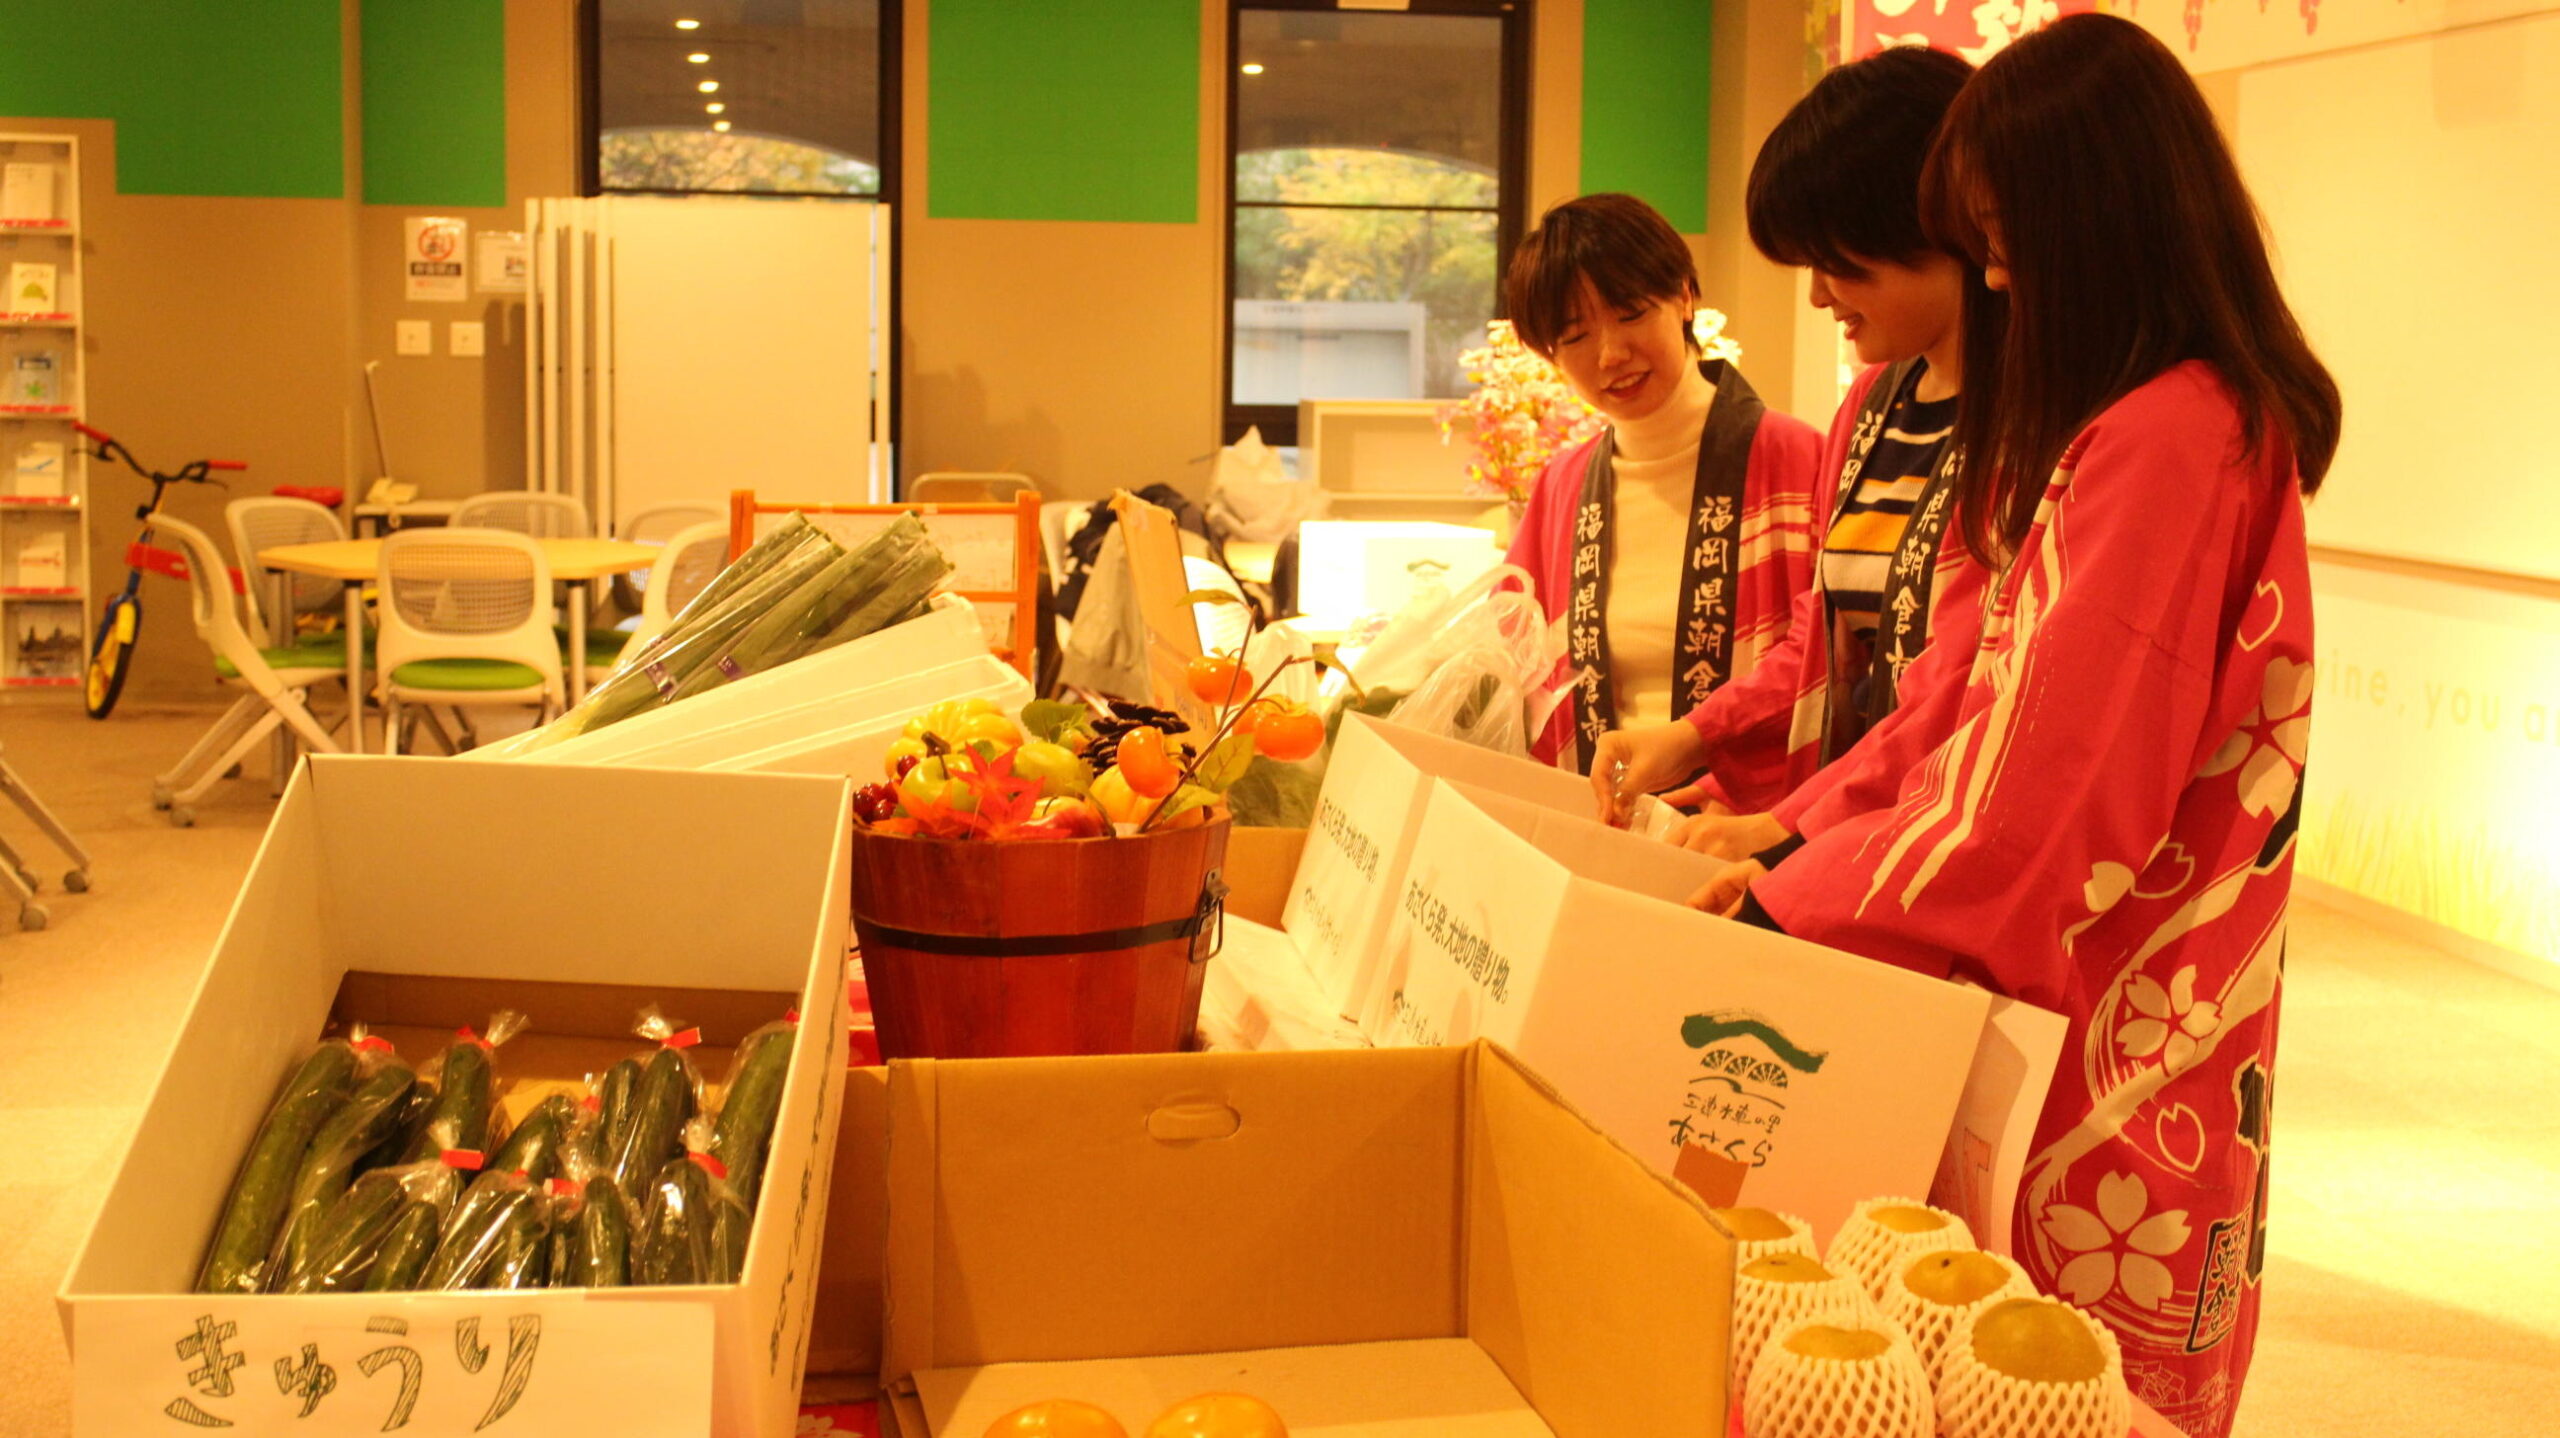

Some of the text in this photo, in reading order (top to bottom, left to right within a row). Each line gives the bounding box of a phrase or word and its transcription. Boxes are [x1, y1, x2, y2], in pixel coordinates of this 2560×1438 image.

[1573, 503, 1608, 743] 福岡県朝倉市
[1683, 495, 1734, 718] 福岡県朝倉
[2424, 680, 2500, 731] you
[1405, 879, 1511, 1005] あさくら発、大地の贈り物。
[163, 1313, 542, 1433] きゅうり
